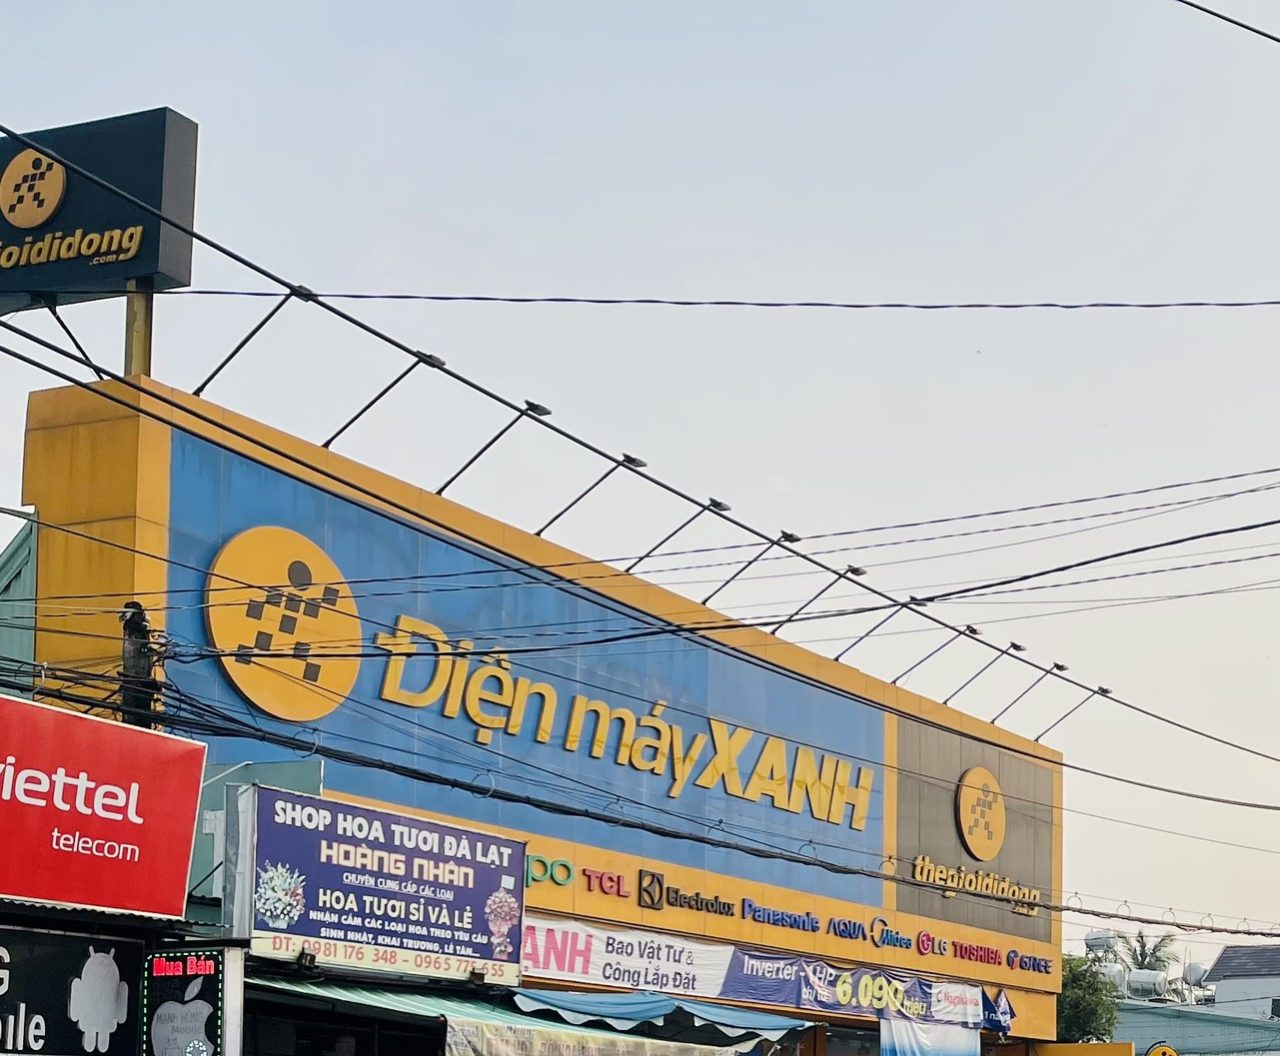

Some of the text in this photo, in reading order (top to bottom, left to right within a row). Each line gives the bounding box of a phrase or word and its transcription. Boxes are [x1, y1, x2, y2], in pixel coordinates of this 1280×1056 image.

[0, 226, 144, 269] oididong
[89, 255, 117, 267] .com
[374, 614, 874, 831] Điện máy XANH
[51, 827, 140, 862] telecom
[274, 800, 512, 869] SHOP HOA TƯƠI ĐÀ LẠT
[320, 839, 475, 890] HOÀNG NHÂN
[526, 855, 575, 888] po
[377, 878, 400, 890] CUNG
[419, 885, 436, 897] CÁC
[582, 868, 632, 898] TCL
[318, 888, 474, 929] HOA TƯƠI SỈ VÀ LẺ
[666, 886, 736, 917] Electrolux
[741, 898, 821, 933] Panasonic
[309, 909, 340, 924] NHẬN
[364, 917, 382, 930] CÁC
[384, 920, 406, 934] LOẠI
[408, 924, 428, 936] HOA
[430, 927, 453, 939] THEO
[320, 927, 345, 940] SINH
[377, 934, 401, 947] KHAI
[827, 917, 868, 941] AQUA
[876, 921, 914, 949] Midea
[153, 955, 215, 977] Mua Bán
[272, 935, 297, 953] ĐT:
[302, 938, 338, 959] 0981
[343, 944, 366, 961] 176
[372, 948, 397, 966] 348
[414, 954, 452, 971] 0965
[482, 962, 506, 978] 655
[521, 925, 594, 976] ẠNH
[605, 936, 694, 965] Bao Vật Tư &
[952, 941, 1002, 966] TOSHIBA
[603, 961, 697, 992] Công Lắp Đặt
[743, 955, 799, 981] Inverter
[836, 972, 905, 1011] 6.090
[0, 1002, 46, 1051] ile
